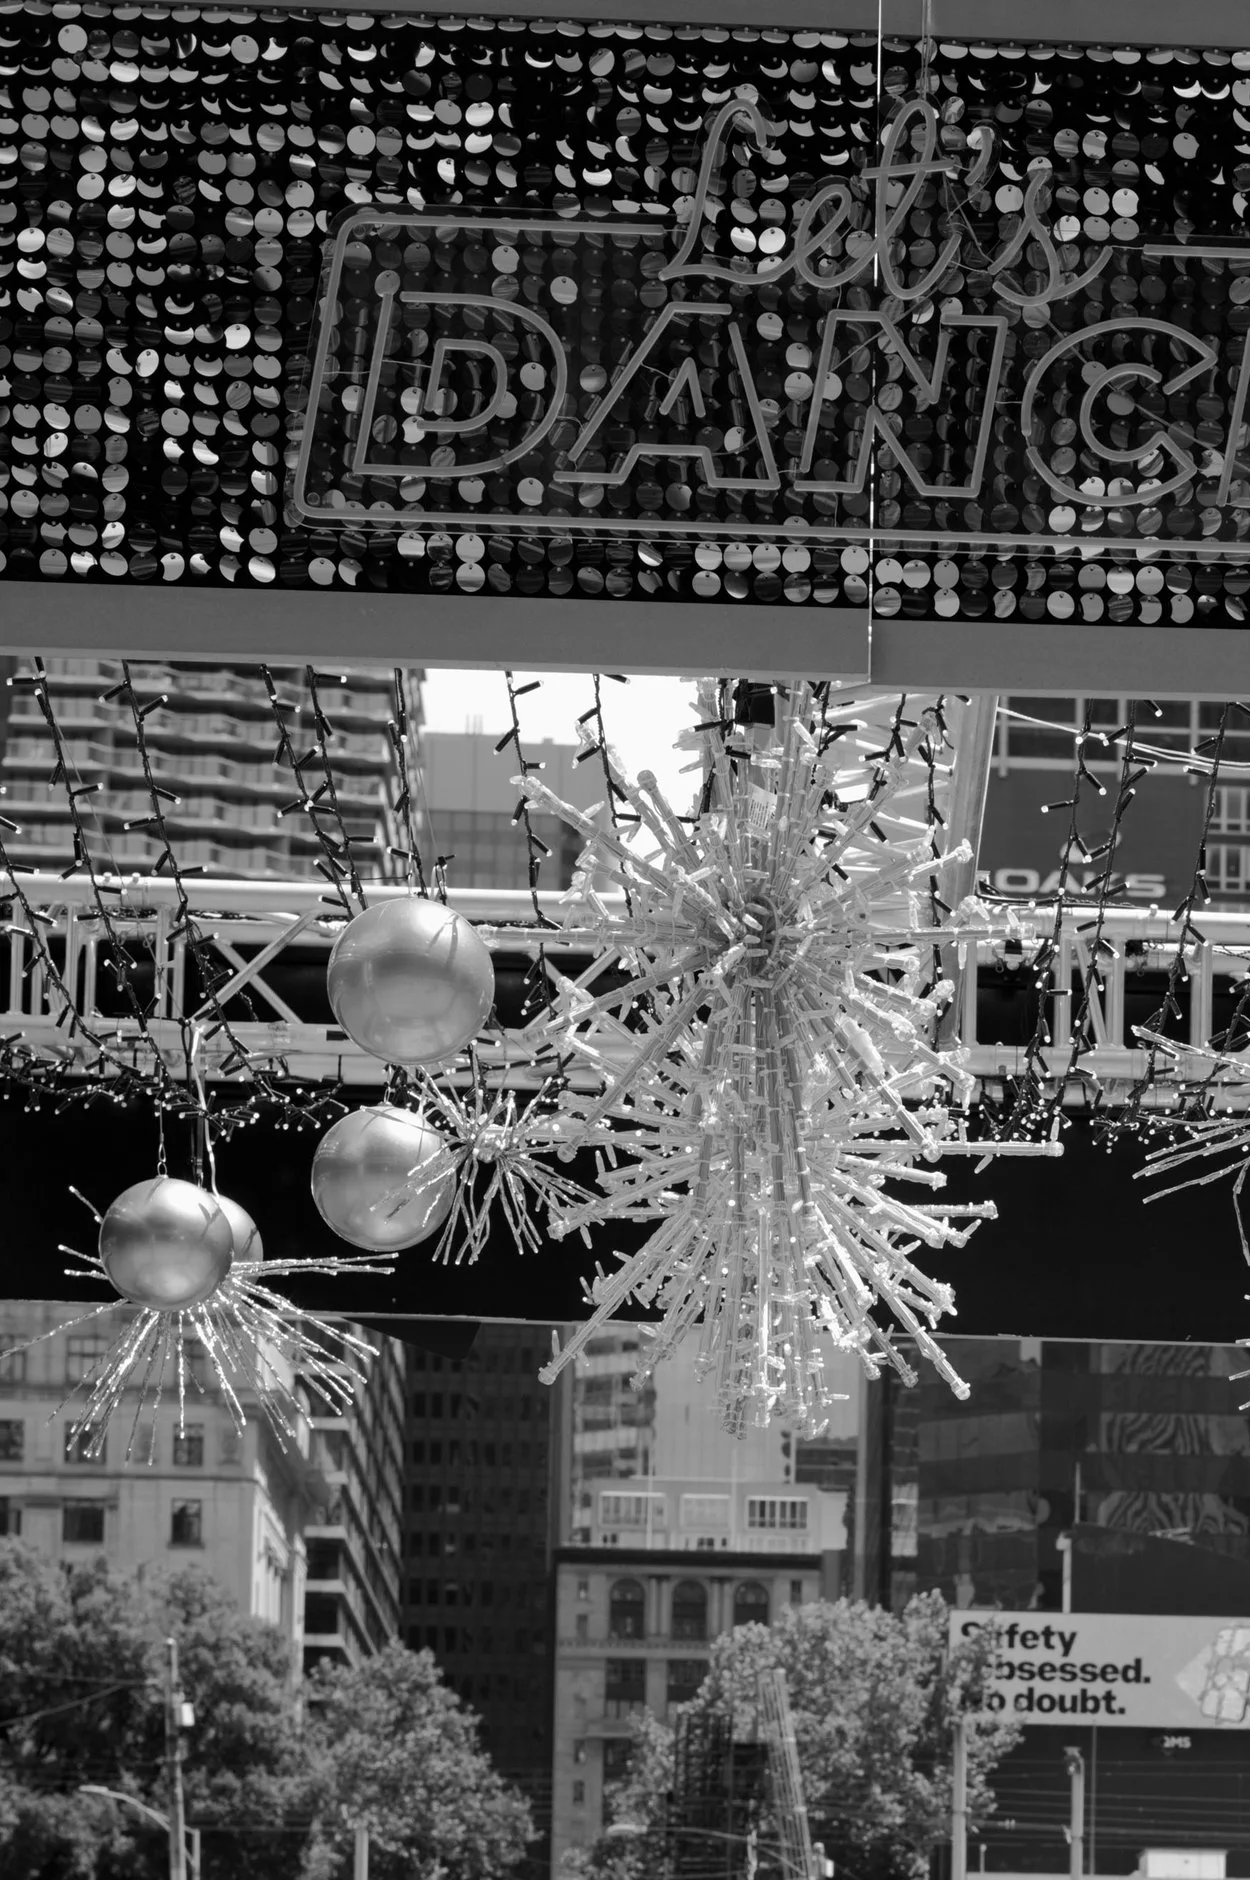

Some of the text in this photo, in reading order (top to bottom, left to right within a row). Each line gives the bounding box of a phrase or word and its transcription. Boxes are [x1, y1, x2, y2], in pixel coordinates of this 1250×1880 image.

[994, 868, 1167, 899] OAKS
[984, 1655, 1151, 1684] bsessed.
[1013, 1687, 1126, 1715] doubt.
